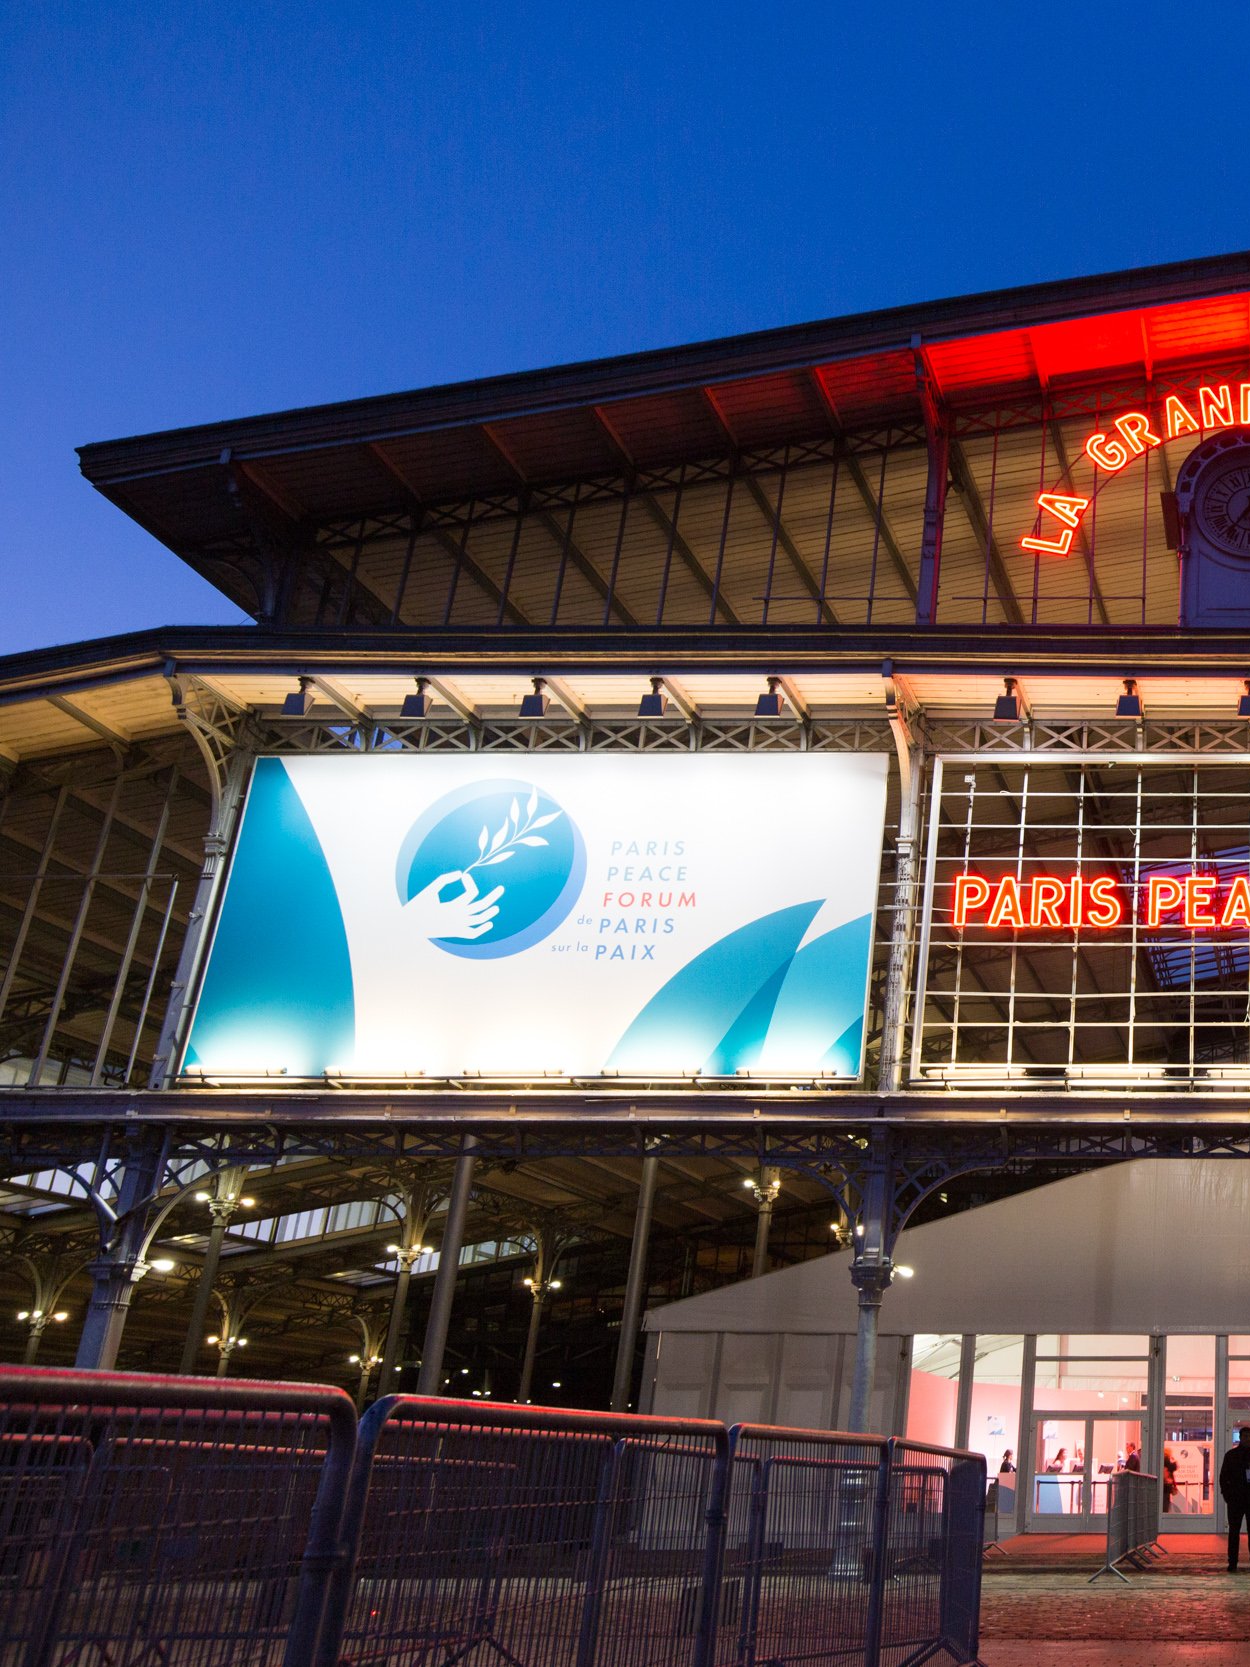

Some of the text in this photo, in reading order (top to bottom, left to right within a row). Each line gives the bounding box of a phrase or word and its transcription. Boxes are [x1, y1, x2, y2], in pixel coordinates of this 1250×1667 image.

[1021, 492, 1089, 556] LA
[611, 840, 685, 857] PARIS
[607, 866, 688, 882] PEACE
[603, 892, 697, 908] FORUM
[953, 876, 1121, 927] PARIS
[577, 914, 675, 934] de PARIS
[552, 941, 656, 960] sur la PAIX
